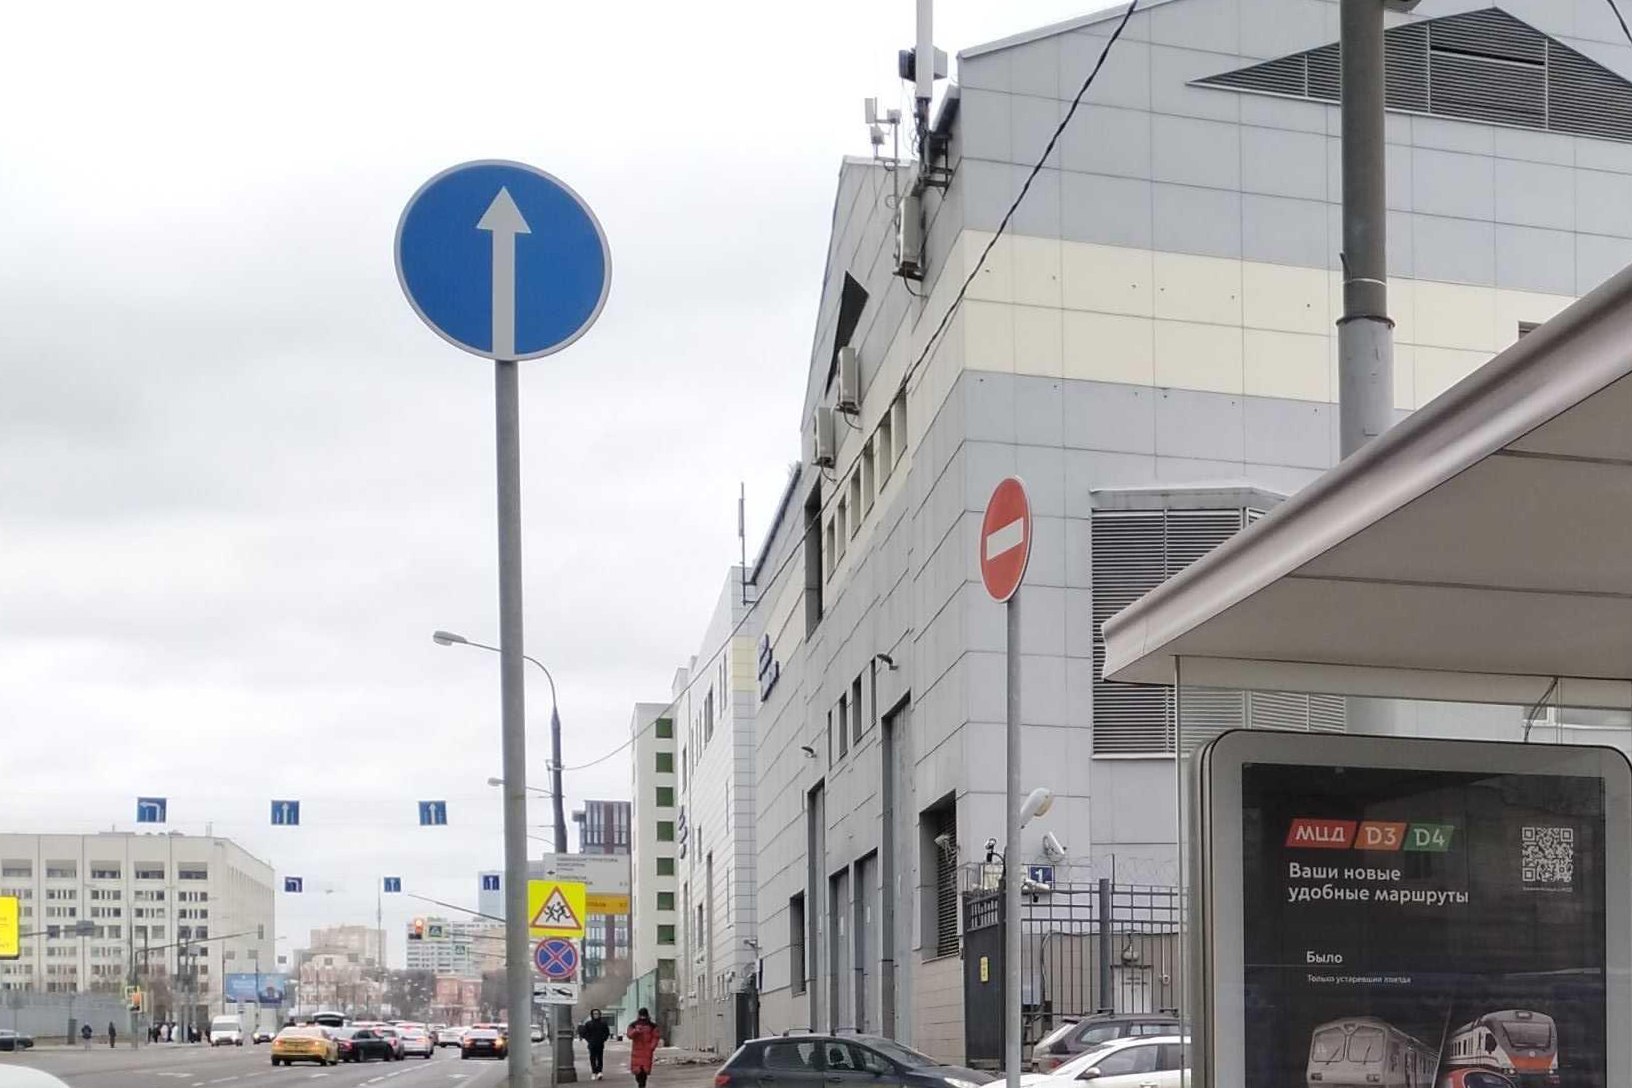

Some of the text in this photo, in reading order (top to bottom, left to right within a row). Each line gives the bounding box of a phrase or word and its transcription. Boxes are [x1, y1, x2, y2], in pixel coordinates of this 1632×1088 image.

[1295, 825, 1445, 847] МЦД D3 D4
[1289, 862, 1401, 880] Ваши новые
[1288, 884, 1469, 905] удобные маршруты
[1306, 951, 1343, 963] Было
